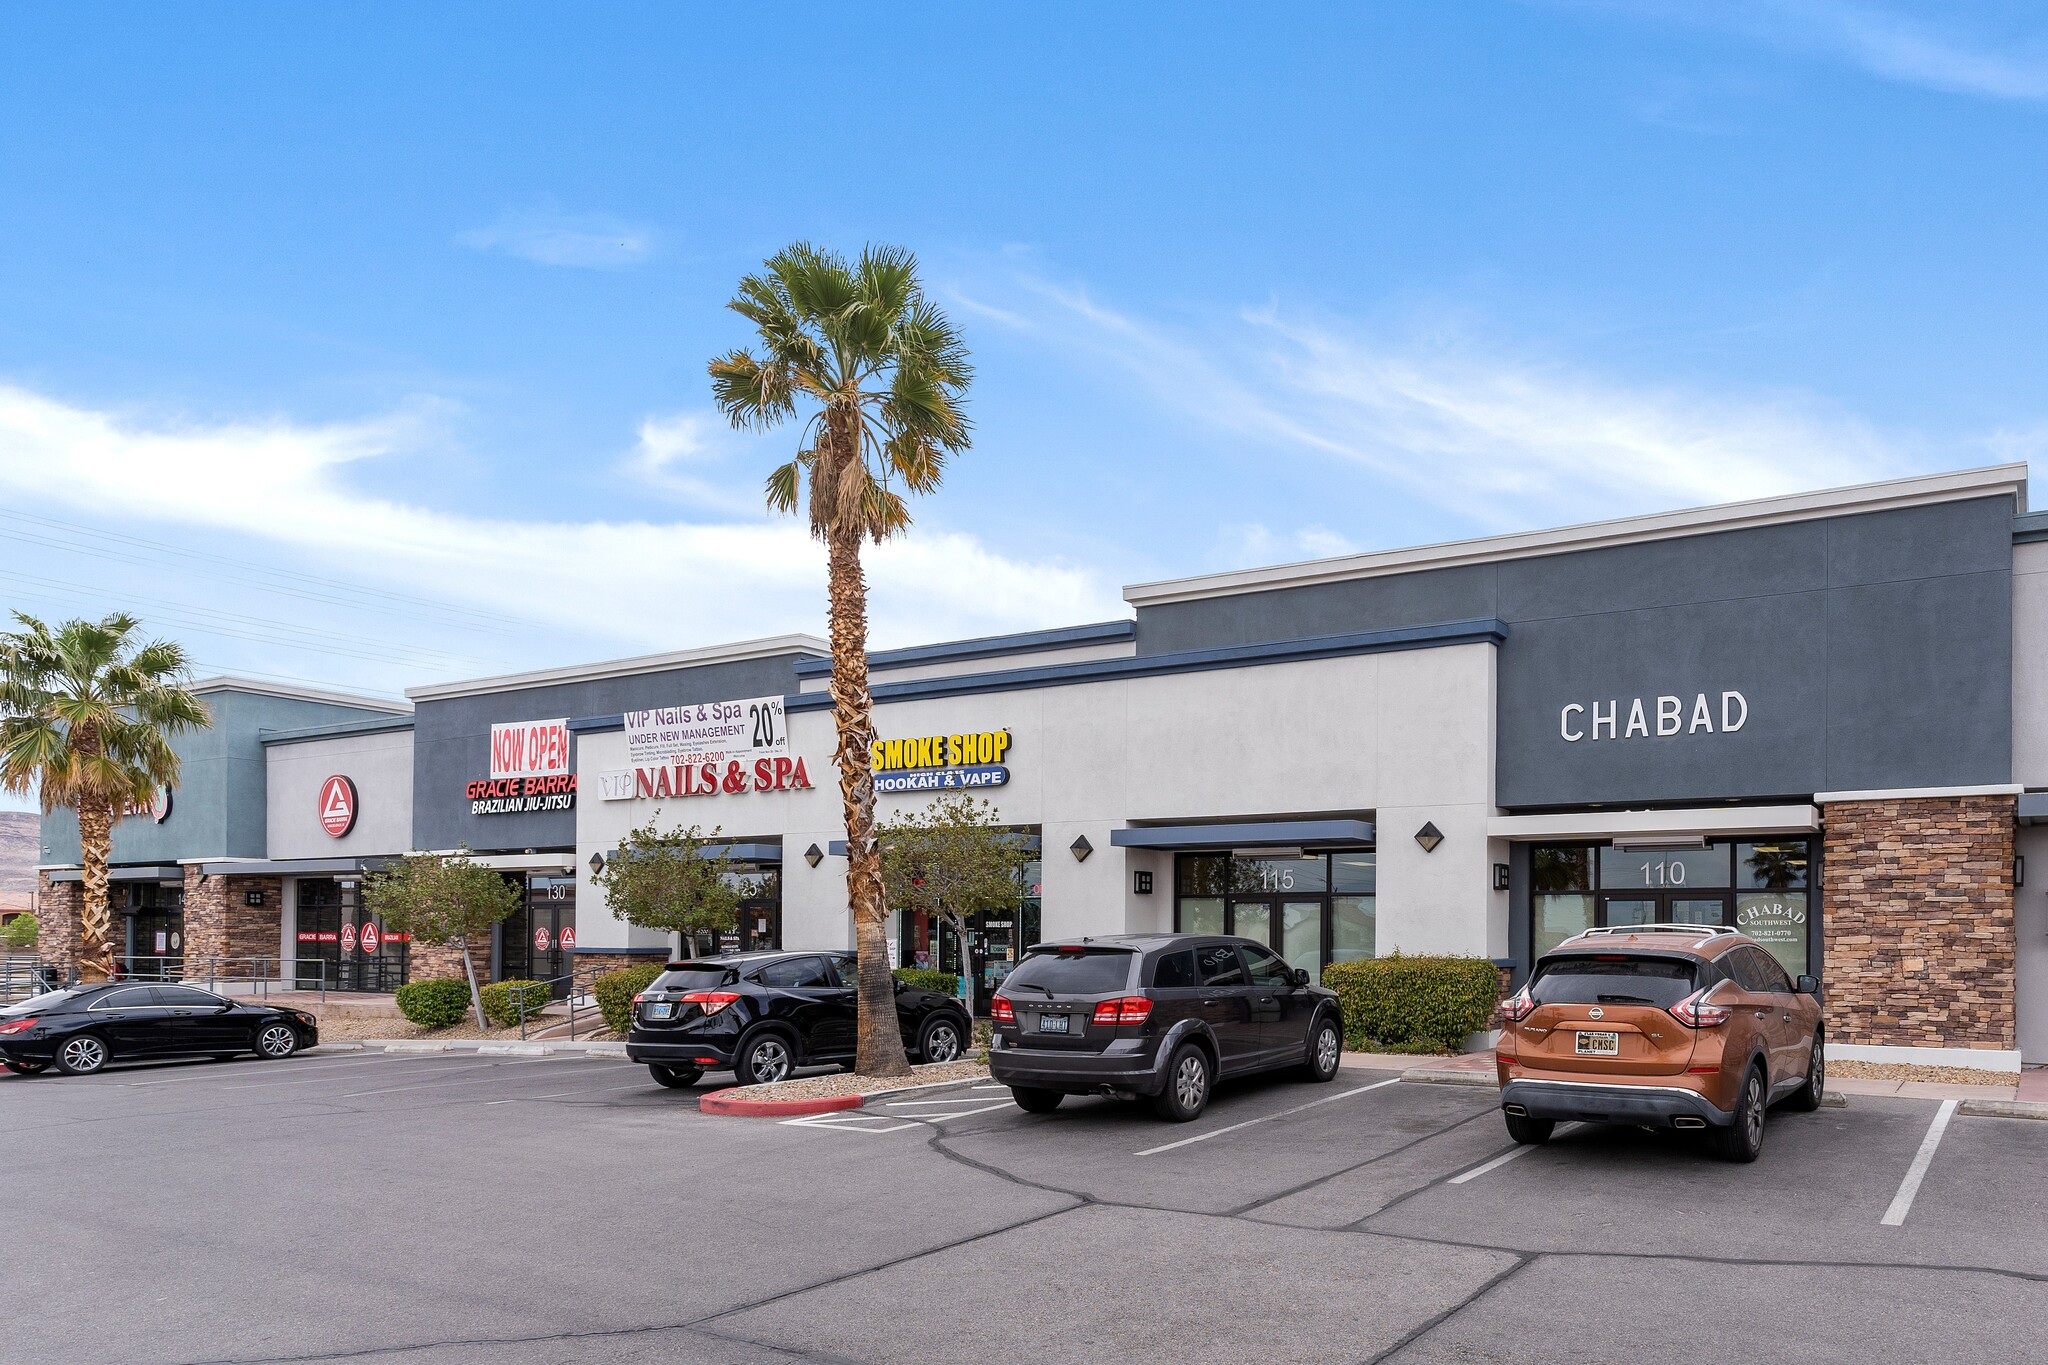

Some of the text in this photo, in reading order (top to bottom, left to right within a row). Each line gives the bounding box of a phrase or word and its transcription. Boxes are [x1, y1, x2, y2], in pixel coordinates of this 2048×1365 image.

[627, 701, 742, 729] VIP Nails & Spa
[1560, 690, 1748, 742] CHABAD
[628, 724, 746, 745] UNDER NEW MANAGEMENT
[776, 737, 786, 746] off
[493, 725, 567, 772] NOW OPEN
[671, 752, 725, 766] 702-822-6200
[872, 731, 1008, 770] SMOKE SHOP
[466, 774, 577, 798] GRACIE BARRA
[600, 772, 632, 796] VIP
[635, 756, 811, 798] NAILS & SPA
[874, 772, 1002, 790] HOOKAH & VAPE
[472, 794, 572, 814] BRAZILIAN JIU-JITSU
[1260, 870, 1294, 889] 115
[1640, 862, 1686, 884] 110
[547, 885, 566, 899] 130
[1736, 903, 1806, 925] CHABAD
